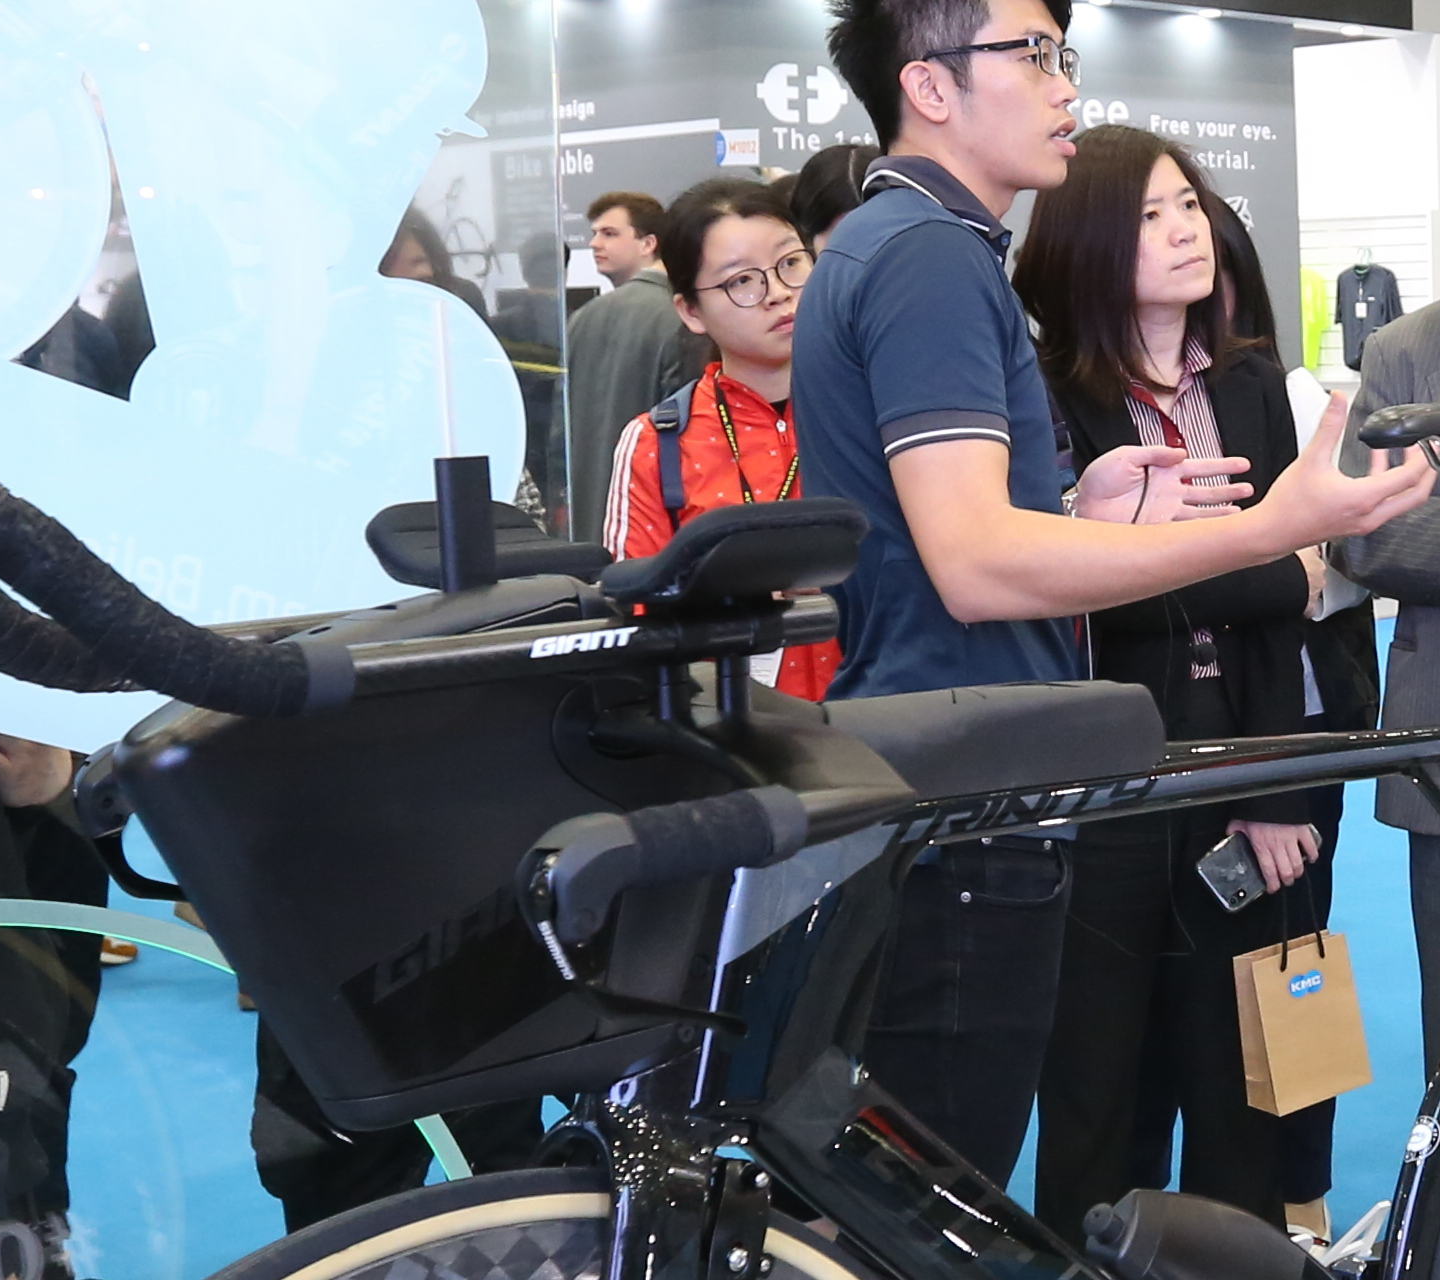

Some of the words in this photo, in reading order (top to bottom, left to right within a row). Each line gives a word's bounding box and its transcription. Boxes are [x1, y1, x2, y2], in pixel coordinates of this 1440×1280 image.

[558, 99, 596, 122] esign
[772, 126, 822, 152] The
[1149, 115, 1190, 136] Free
[1208, 122, 1237, 142] your
[1242, 122, 1277, 142] eye.
[530, 624, 640, 660] GIANT
[1290, 974, 1322, 992] KMC
